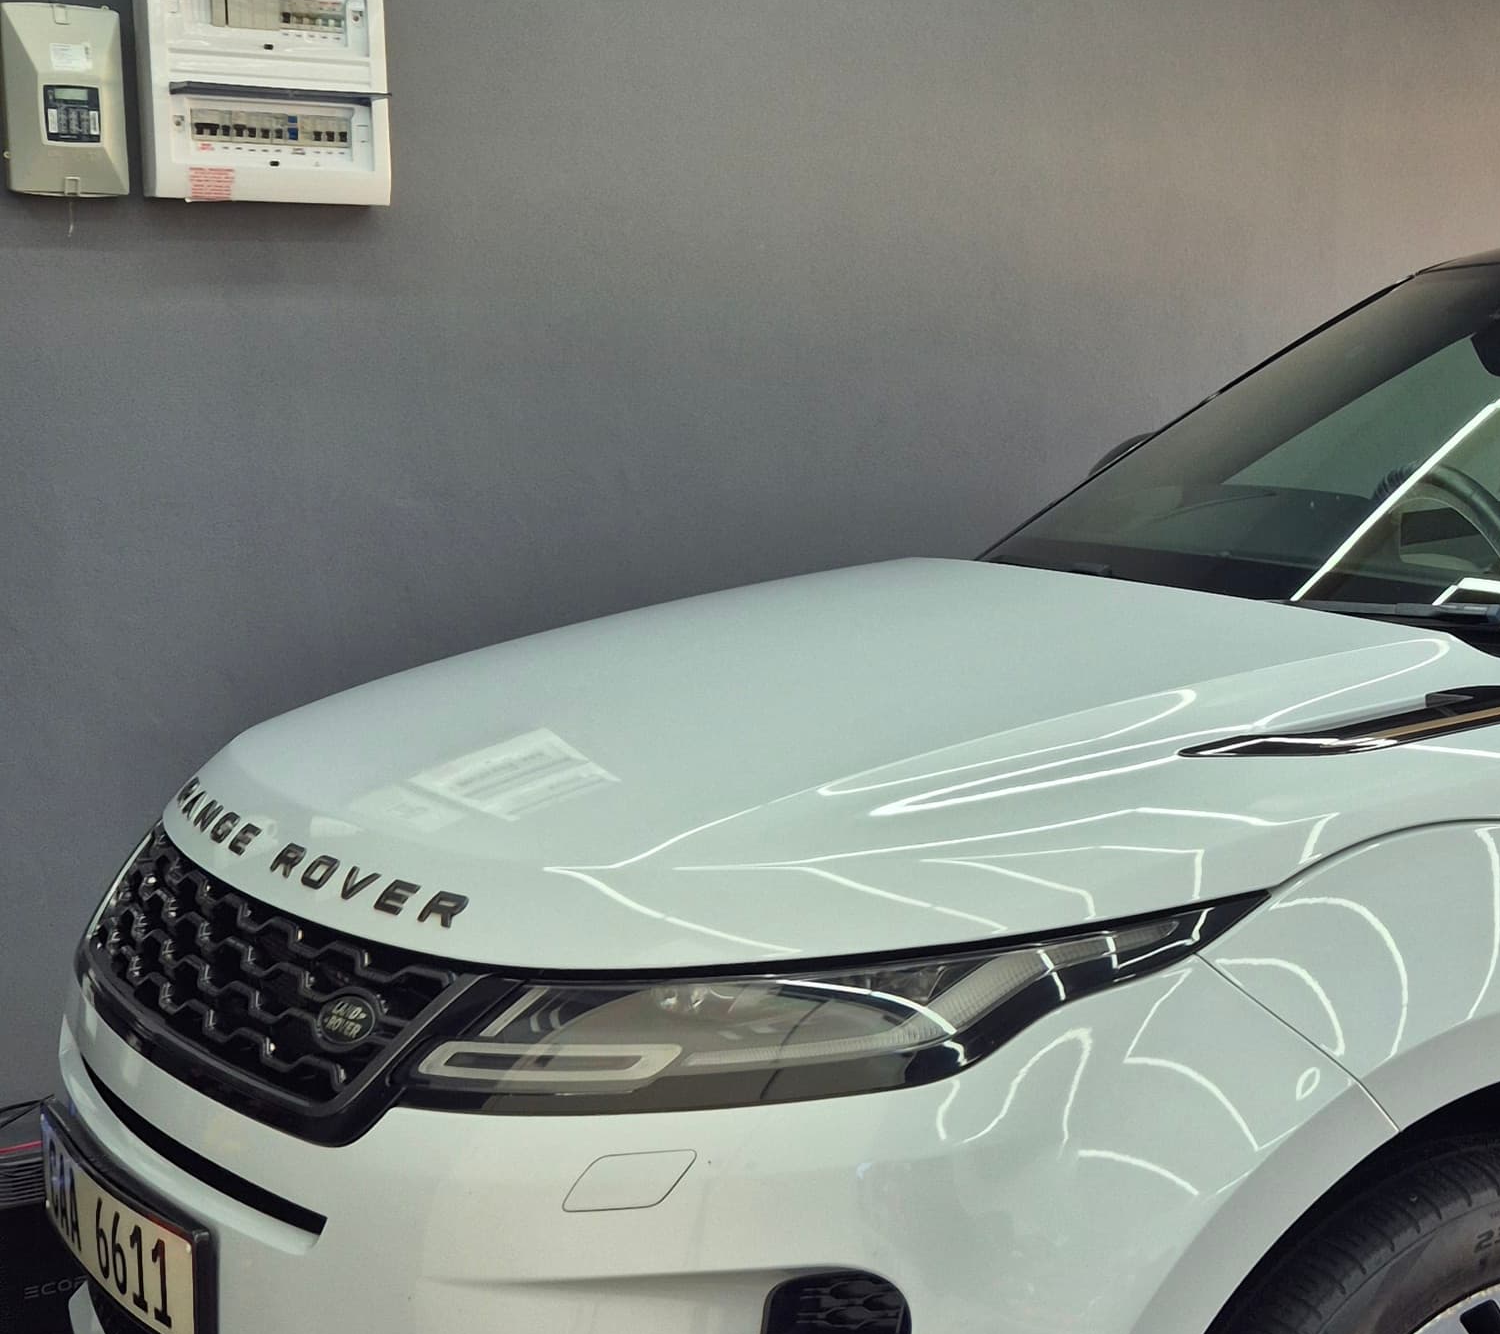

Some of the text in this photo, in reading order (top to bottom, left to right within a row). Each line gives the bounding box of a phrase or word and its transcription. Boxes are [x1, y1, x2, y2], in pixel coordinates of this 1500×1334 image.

[176, 776, 470, 929] RANGE ROVER
[95, 1197, 172, 1329] 6611
